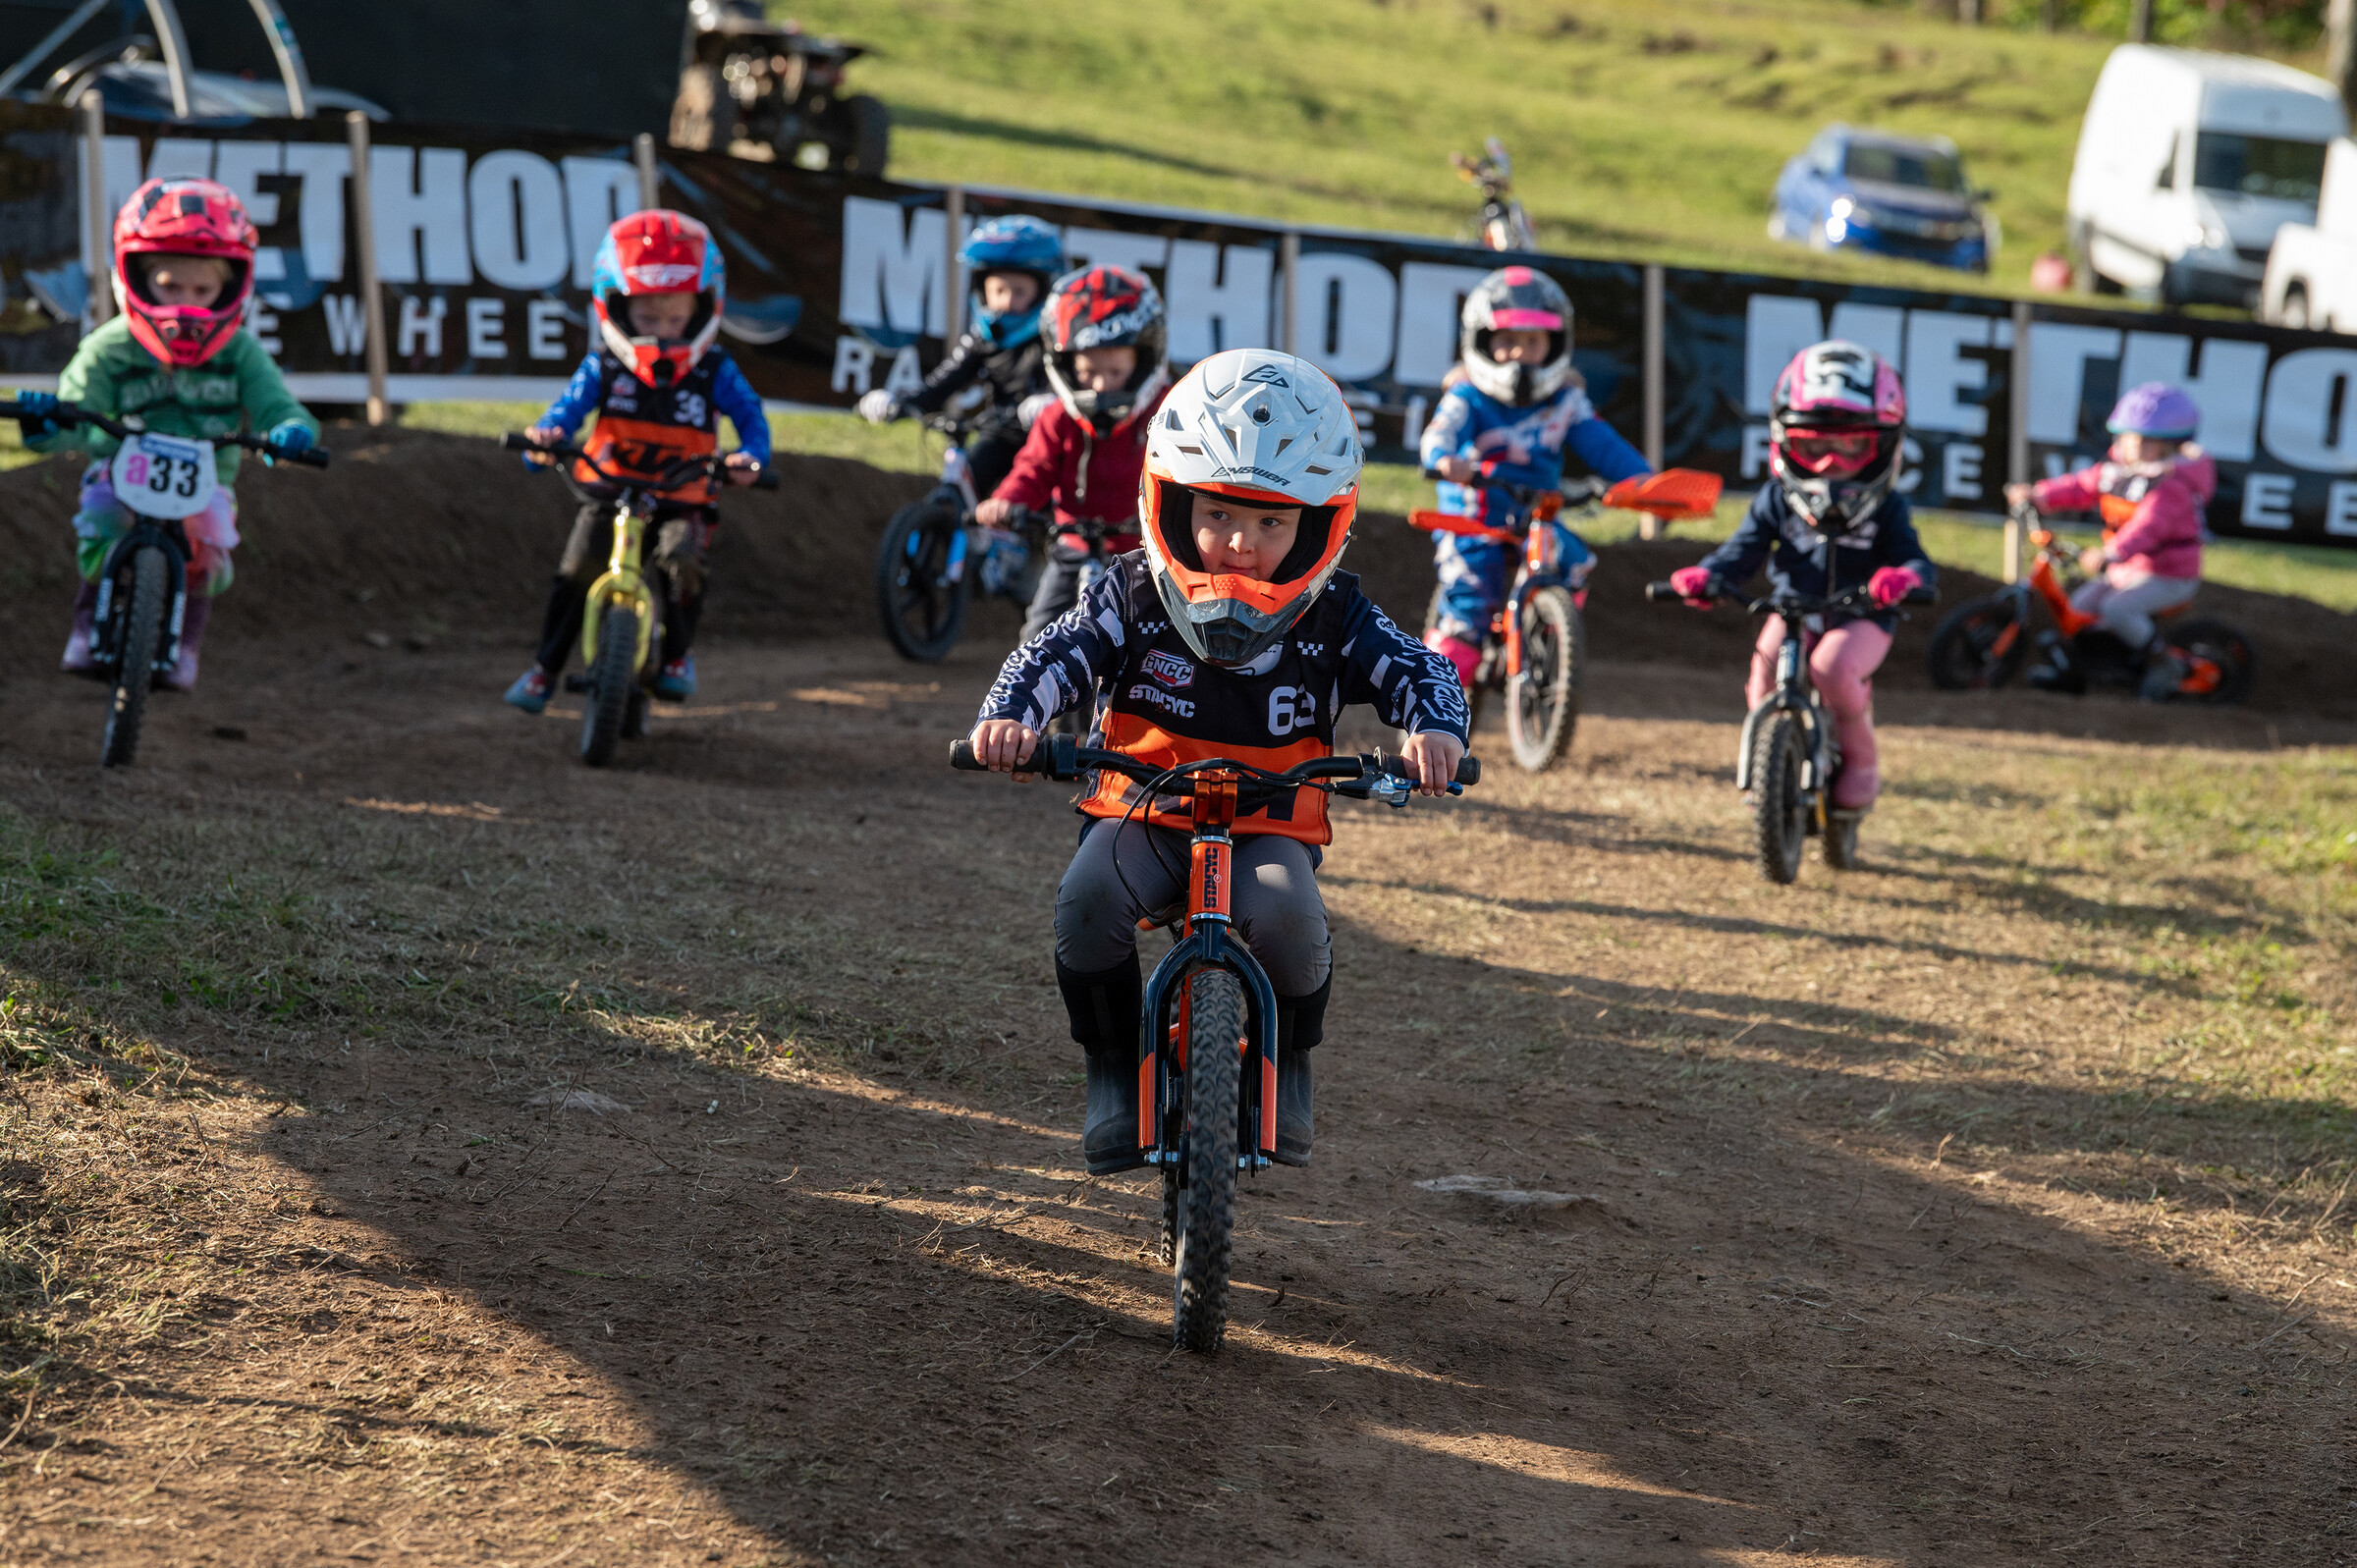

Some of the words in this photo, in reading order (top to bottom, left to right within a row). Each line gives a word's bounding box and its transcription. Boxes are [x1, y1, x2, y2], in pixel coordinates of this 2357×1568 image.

[125, 453, 199, 497] a33
[1141, 655, 1191, 679] GNCC
[1129, 684, 1195, 719] STACYC
[1203, 847, 1218, 909] STACYC
